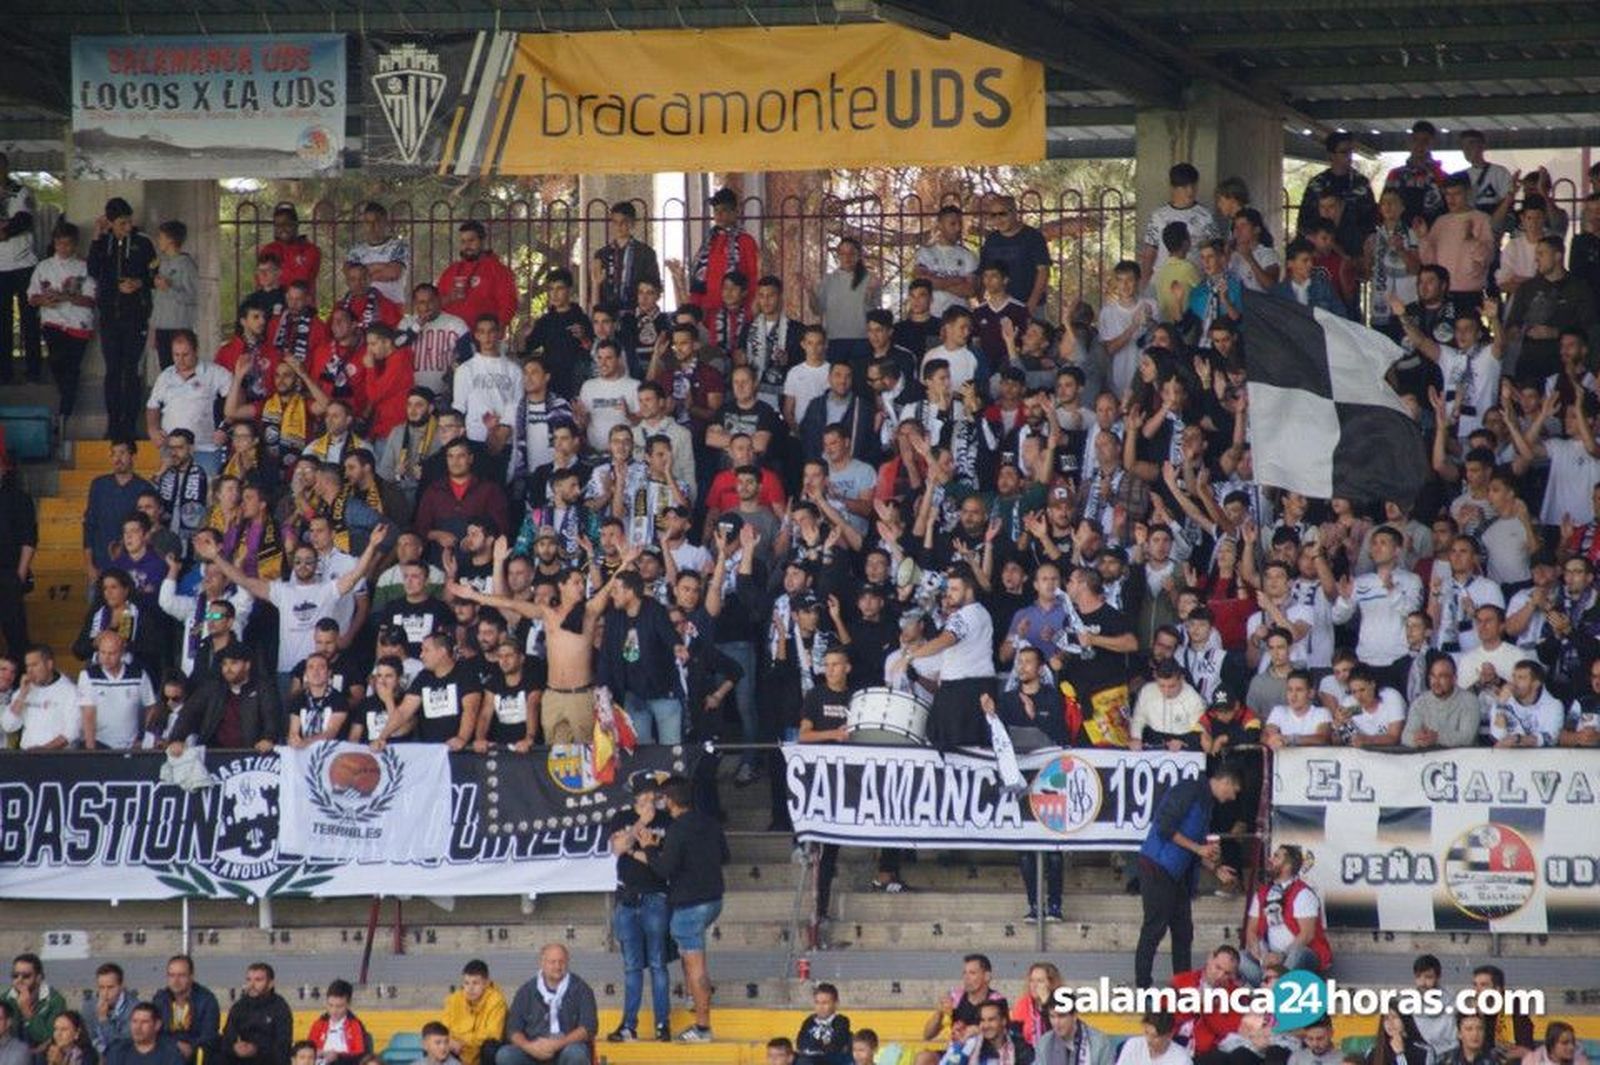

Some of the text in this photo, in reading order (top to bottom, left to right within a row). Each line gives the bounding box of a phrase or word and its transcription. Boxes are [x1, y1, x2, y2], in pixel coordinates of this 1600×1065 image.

[108, 44, 311, 75] SALAMANCA UDS
[81, 77, 336, 112] LOCOS X LA UDS
[542, 69, 1012, 138] bracamonteUDS
[786, 754, 1024, 830] SALAMANCA
[1110, 759, 1200, 830] 19
[1306, 759, 1374, 801] EL
[0, 781, 223, 866] BASTION
[1342, 847, 1437, 886] PEÑA
[1545, 856, 1600, 887] UD
[49, 933, 72, 945] 22
